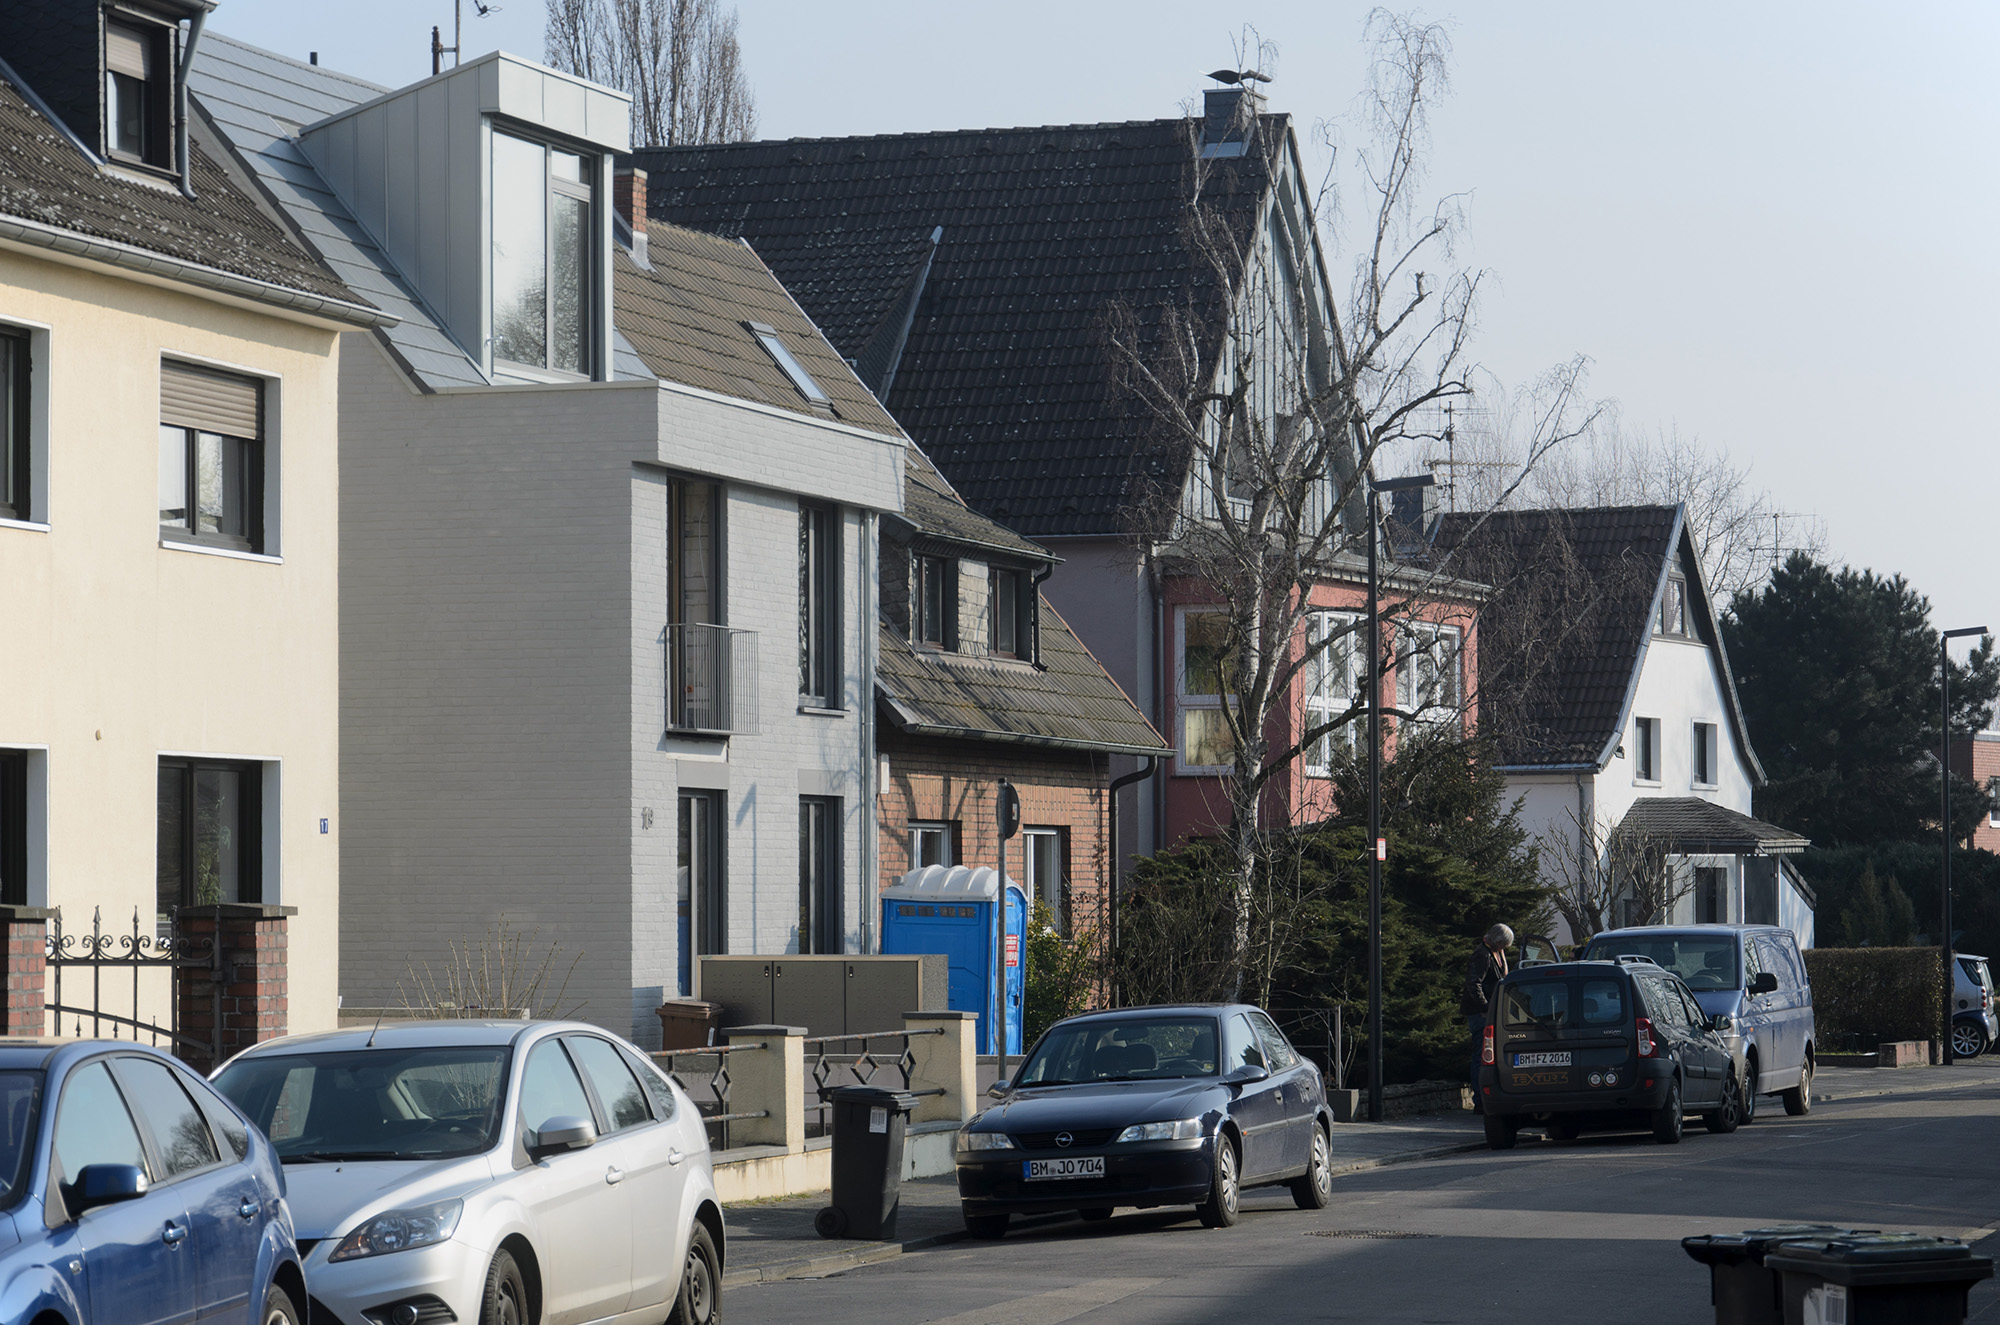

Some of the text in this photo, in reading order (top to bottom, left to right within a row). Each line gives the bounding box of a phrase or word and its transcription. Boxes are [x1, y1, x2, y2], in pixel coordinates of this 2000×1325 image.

[320, 820, 328, 833] 17
[1520, 1053, 1571, 1065] BM FZ 2016
[1031, 1159, 1103, 1176] BM JO 704
